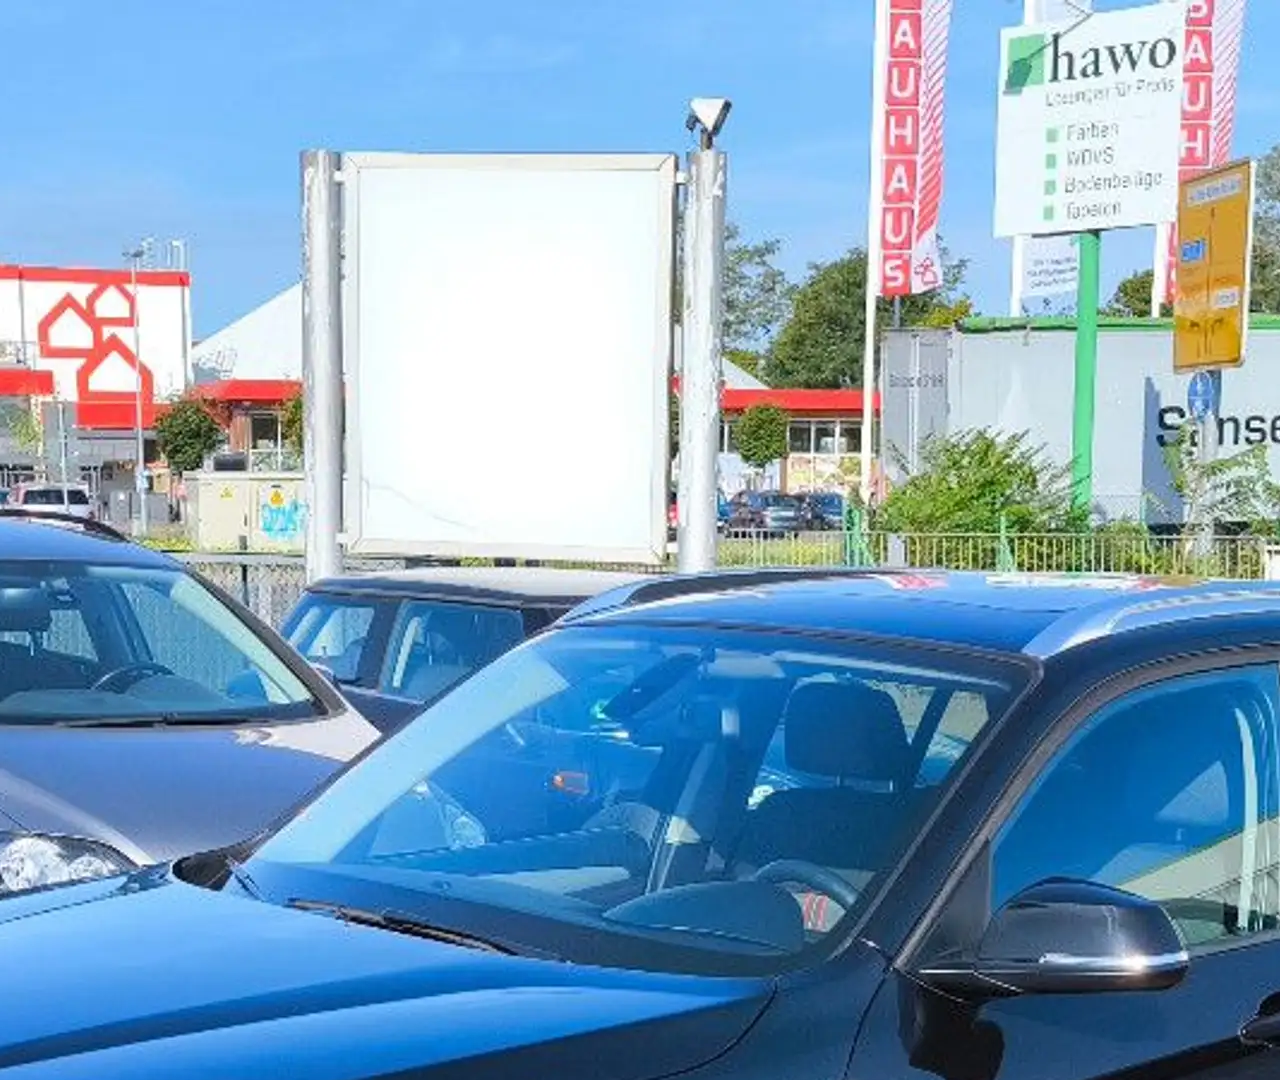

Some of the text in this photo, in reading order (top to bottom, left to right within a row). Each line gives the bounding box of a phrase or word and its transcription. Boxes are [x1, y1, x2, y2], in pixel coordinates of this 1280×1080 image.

[1048, 32, 1177, 83] hawo
[883, 18, 917, 288] AUHAUS
[1066, 121, 1120, 142] Farben
